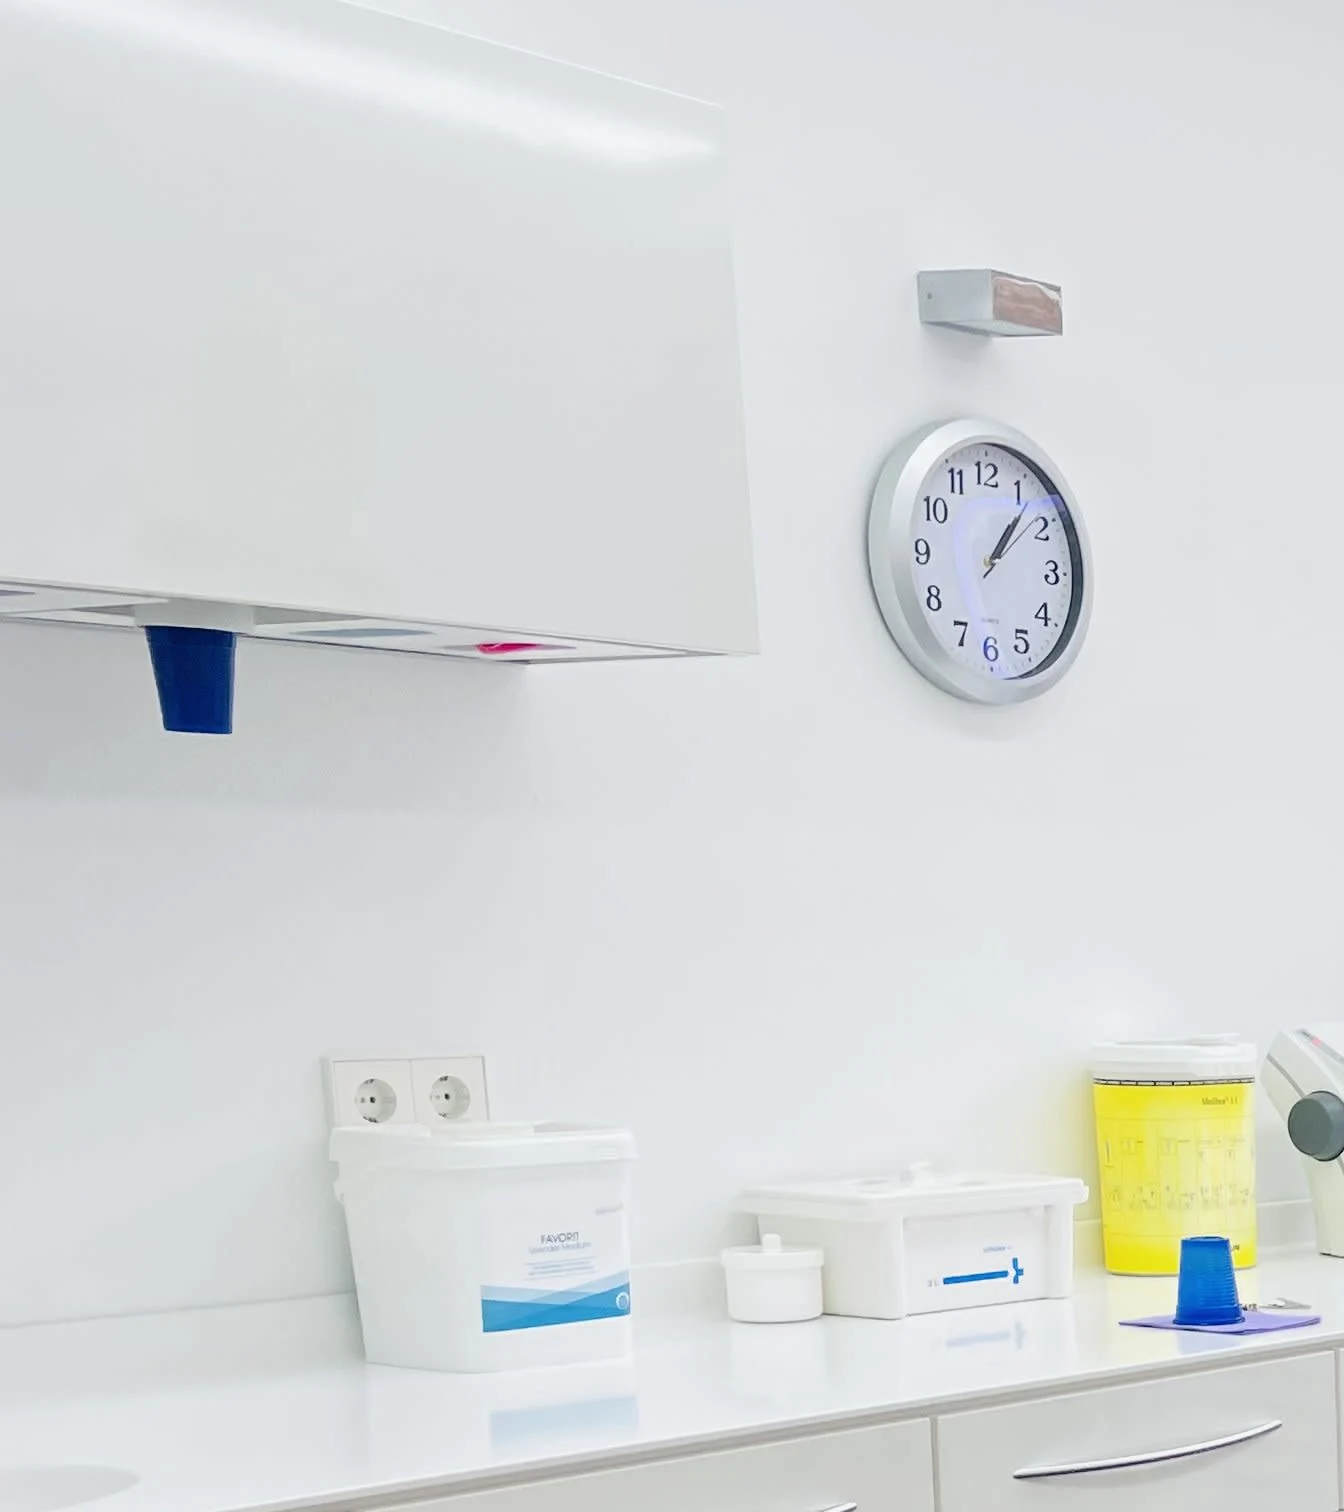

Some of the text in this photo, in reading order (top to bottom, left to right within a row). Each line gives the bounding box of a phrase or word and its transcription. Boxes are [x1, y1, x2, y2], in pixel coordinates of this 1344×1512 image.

[947, 467, 965, 495] 11
[974, 460, 999, 488] 12
[1013, 480, 1021, 505] 1
[923, 496, 948, 524] 10
[1034, 516, 1050, 541] 2
[914, 538, 931, 565] 9
[1043, 560, 1060, 586] 3
[926, 585, 942, 611] 8
[1034, 602, 1051, 627] 4
[953, 620, 968, 647] 7
[1013, 629, 1030, 654] 5
[983, 636, 999, 662] 6
